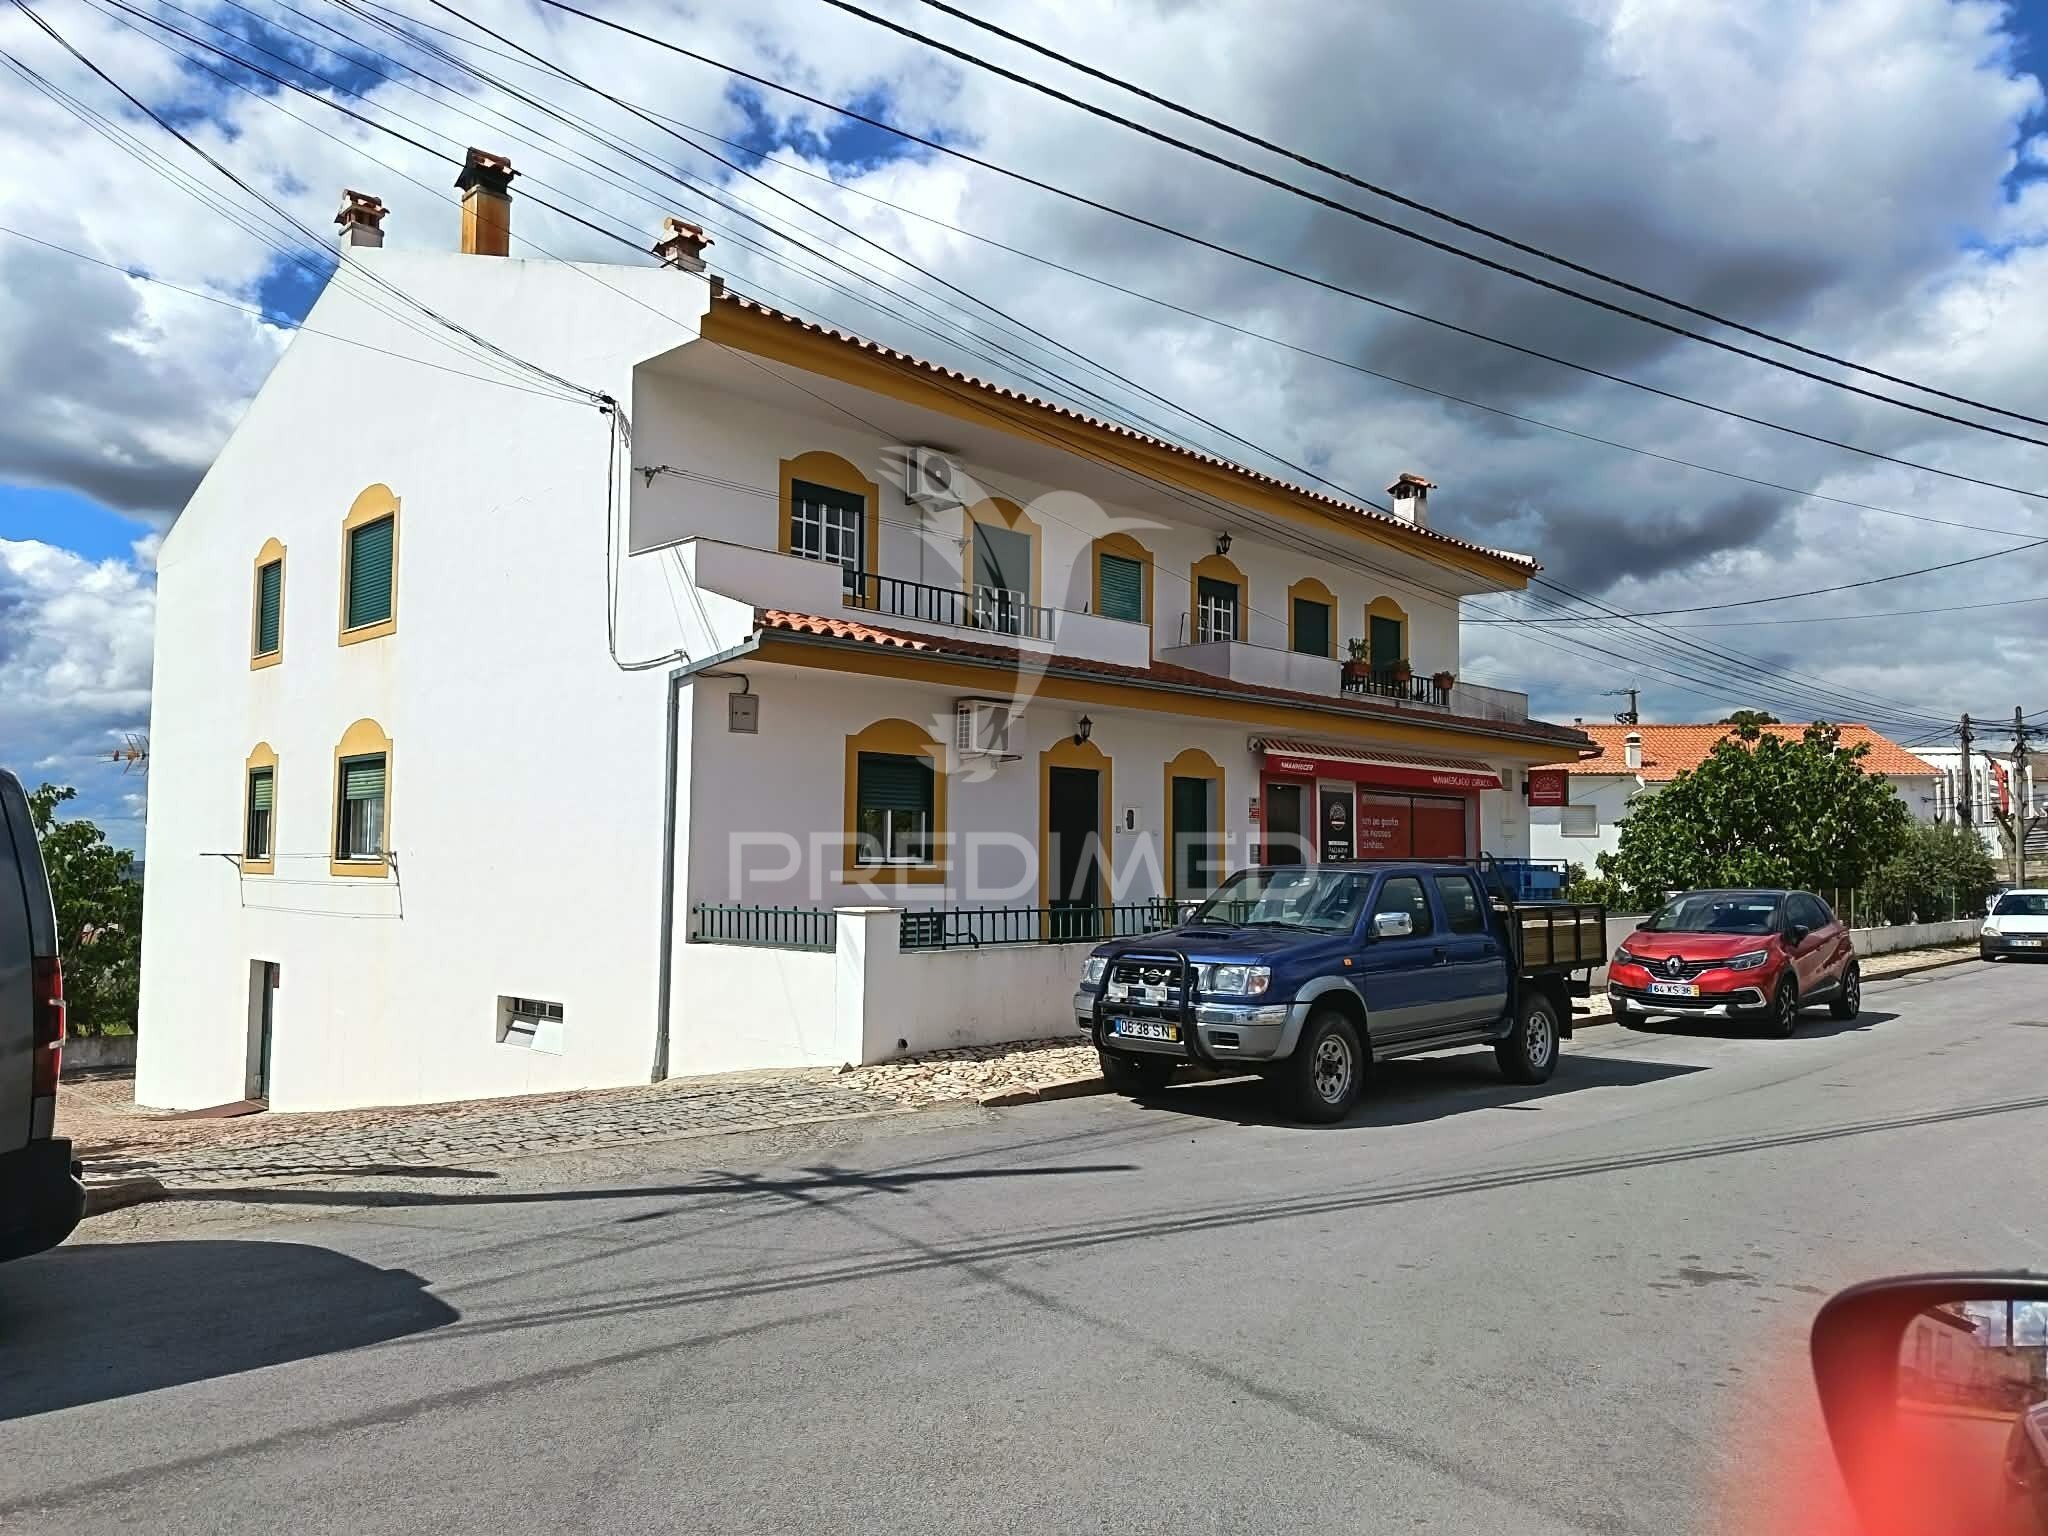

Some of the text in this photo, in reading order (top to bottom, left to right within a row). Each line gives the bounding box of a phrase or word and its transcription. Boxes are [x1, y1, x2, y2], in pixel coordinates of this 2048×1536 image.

[1122, 1020, 1170, 1038] 06 38 SN
